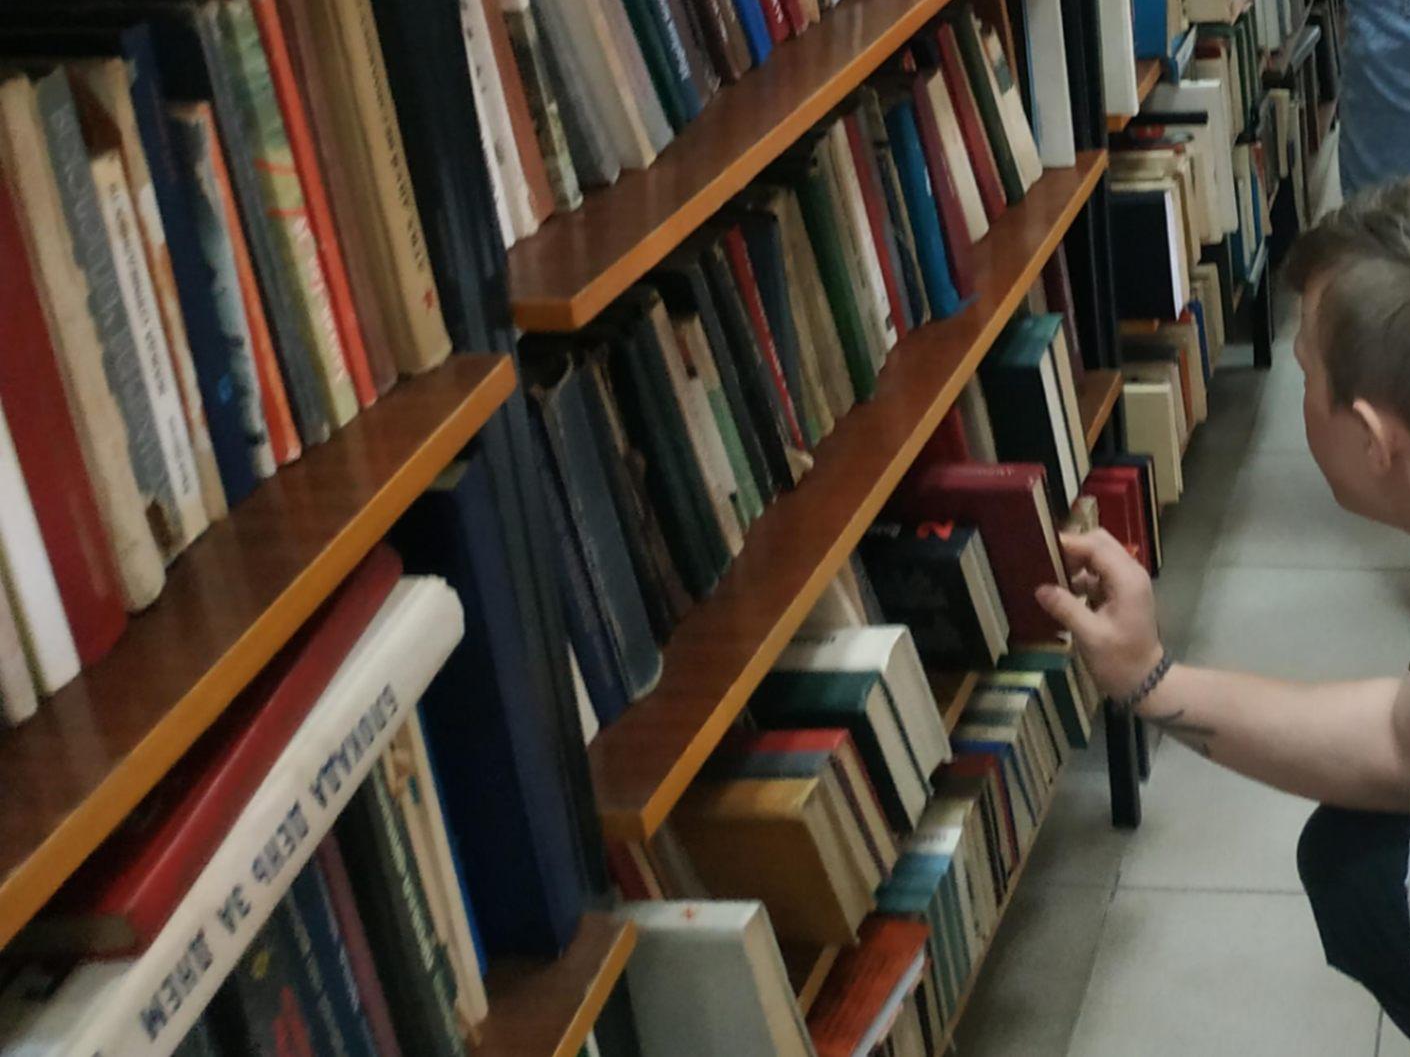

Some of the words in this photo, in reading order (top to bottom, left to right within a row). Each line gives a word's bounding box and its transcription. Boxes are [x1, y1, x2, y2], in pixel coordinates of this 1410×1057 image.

[309, 683, 398, 808] БЛОКАДА
[250, 803, 311, 884] ДЕНЬ
[216, 882, 253, 937] ЗА
[141, 929, 212, 1043] ДНЕМ
